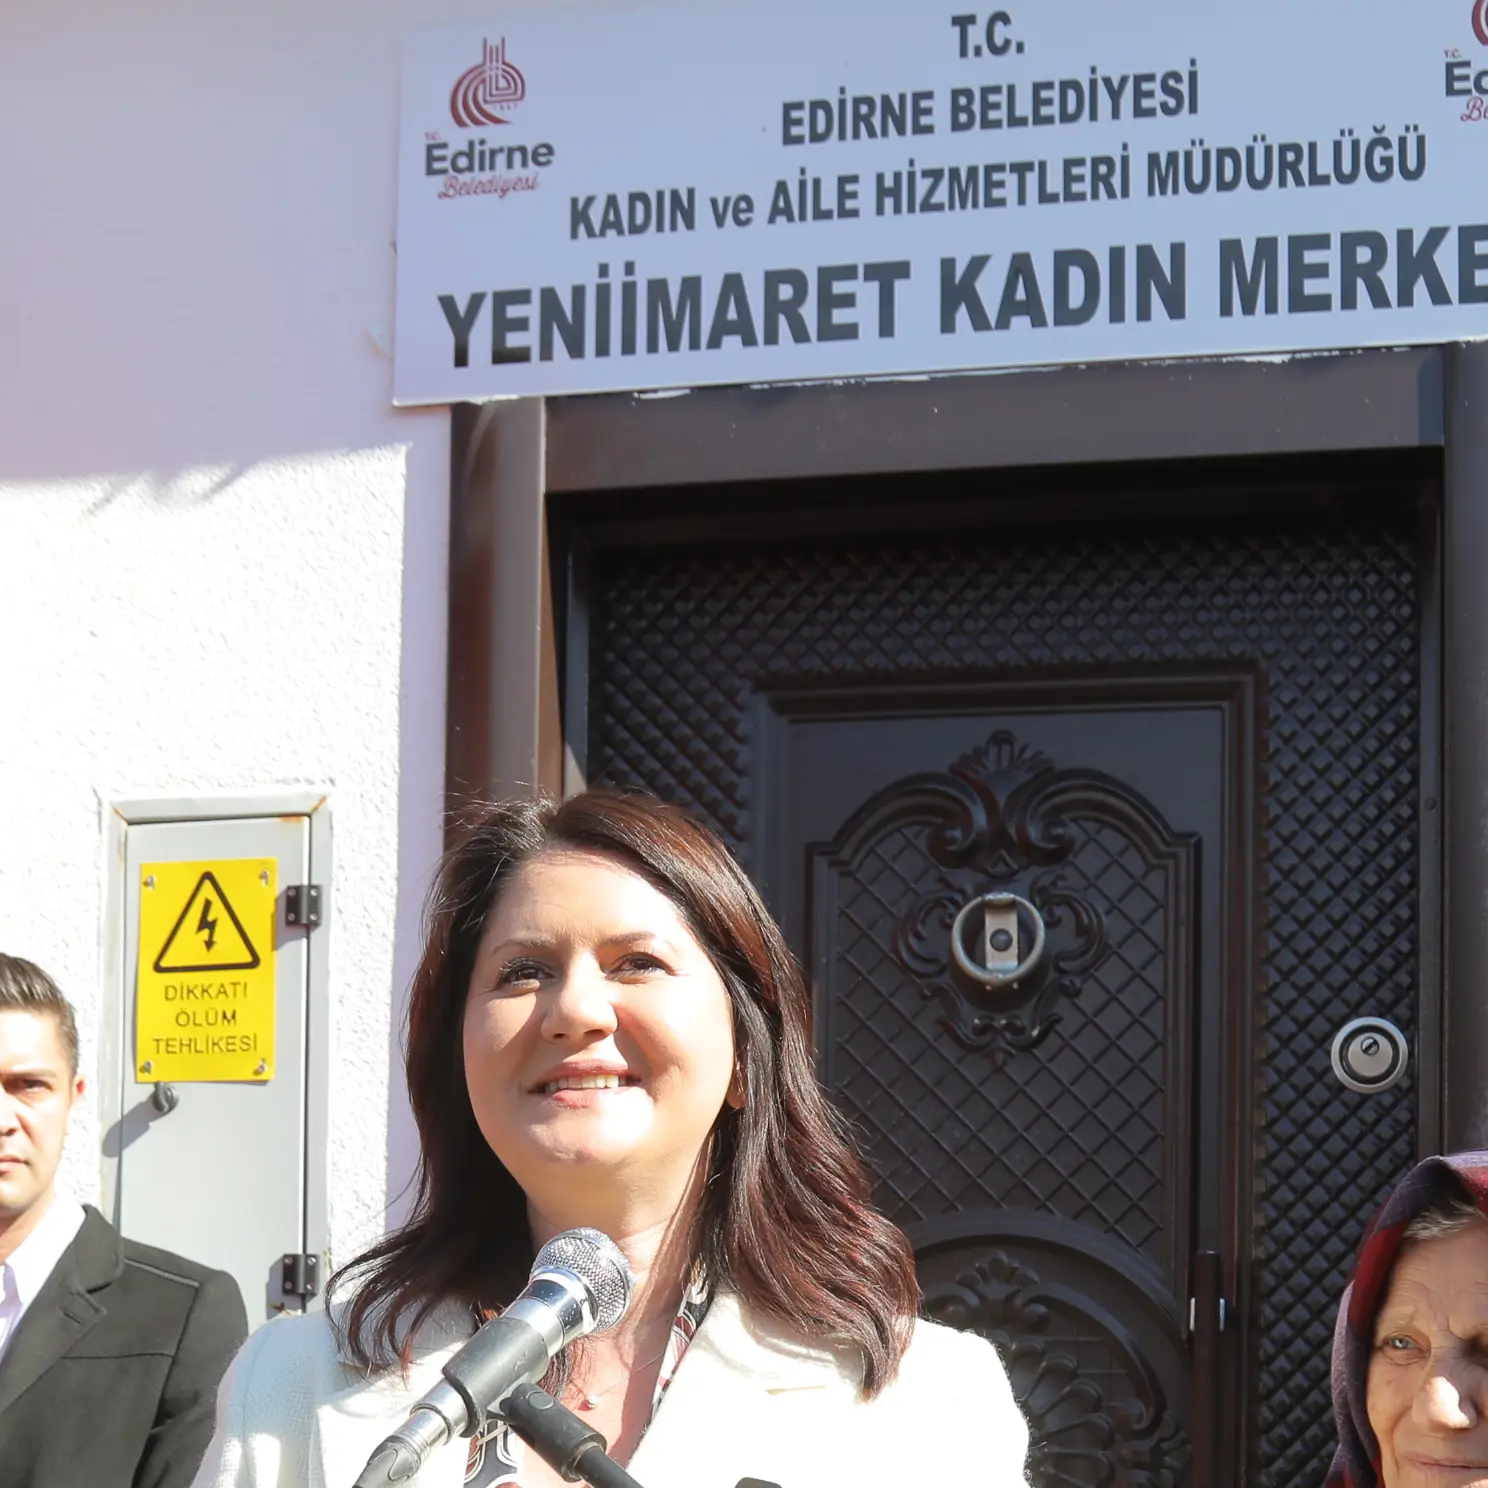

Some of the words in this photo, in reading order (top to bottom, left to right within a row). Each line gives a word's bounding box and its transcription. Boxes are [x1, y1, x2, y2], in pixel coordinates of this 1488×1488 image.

[950, 10, 1025, 59] T.C.
[782, 85, 935, 147] EDİRNE
[950, 57, 1199, 133] BELEDİYESİ
[425, 137, 555, 177] Edirne
[569, 186, 696, 241] KADIN
[709, 193, 755, 229] ve
[767, 166, 861, 225] AİLE
[875, 141, 1131, 217] HİZMETLERİ
[1147, 123, 1427, 198] MÜDÜRLÜĞÜ
[436, 259, 912, 370] YENİİMARET
[939, 241, 1187, 335] KADIN
[175, 1006, 236, 1027] ÖLÜM
[153, 1032, 258, 1055] TEHLİKESİ
